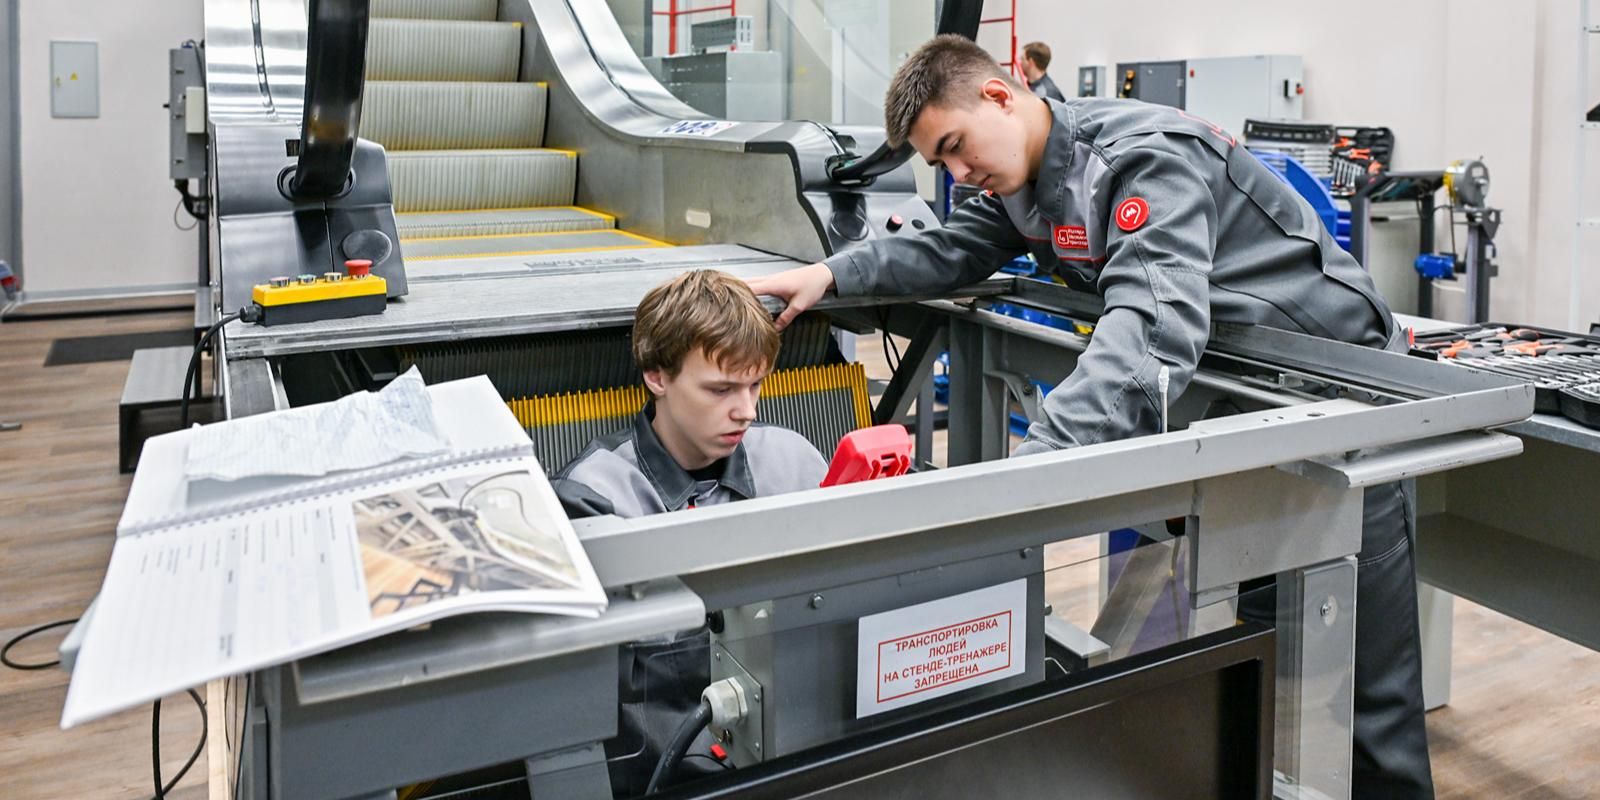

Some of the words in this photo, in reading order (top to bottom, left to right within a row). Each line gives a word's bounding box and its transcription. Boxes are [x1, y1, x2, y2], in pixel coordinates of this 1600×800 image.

[896, 618, 998, 652] ТРАНСПОРТИРОВКА
[928, 639, 967, 658] ЛЮДЕЙ
[884, 671, 899, 683] НА
[902, 642, 1007, 678] СТЕНДЕ-ТРЕНАЖЕРЕ
[914, 664, 979, 689] ЗАПРЕЩЕНА
